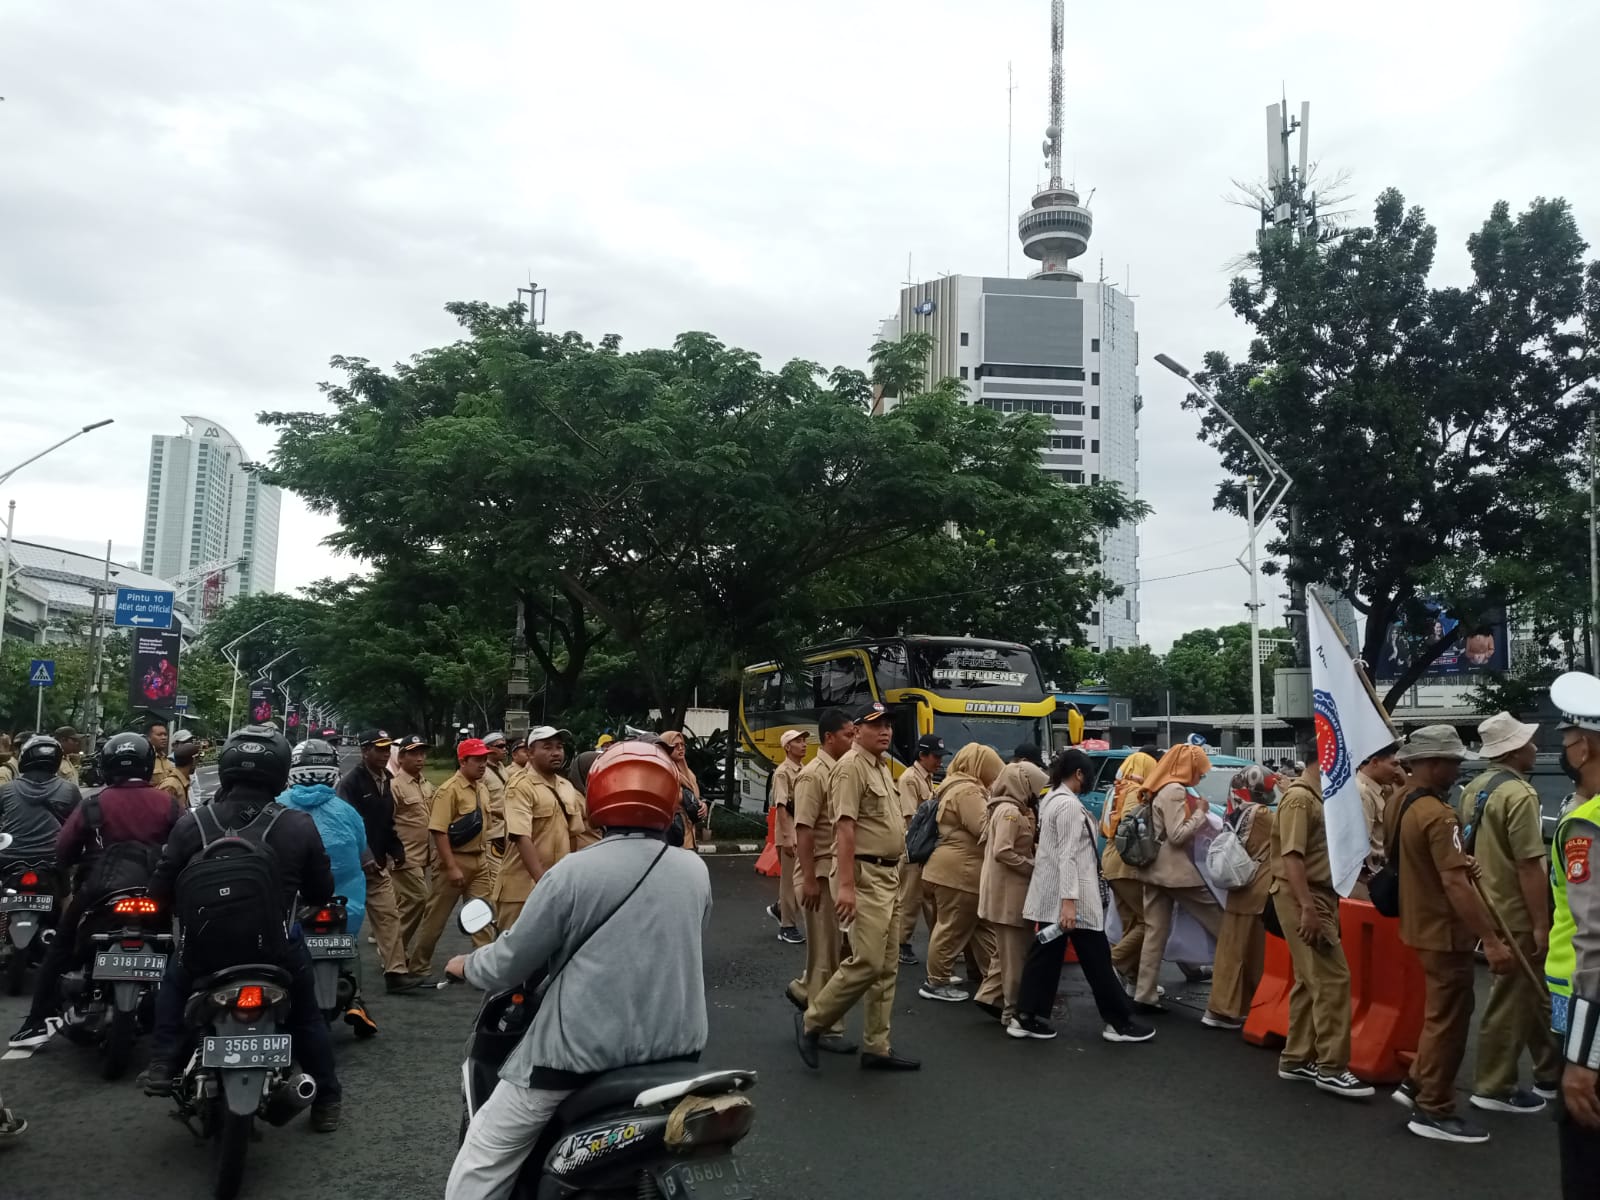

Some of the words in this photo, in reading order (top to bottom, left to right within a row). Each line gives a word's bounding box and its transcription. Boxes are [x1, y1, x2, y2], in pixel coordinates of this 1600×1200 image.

[127, 593, 150, 602] Pintu
[154, 595, 164, 603] 10
[118, 602, 134, 611] Atlet
[135, 604, 147, 612] dan
[148, 604, 170, 614] Official
[966, 670, 1029, 684] FLUENCY
[965, 703, 1021, 714] DIAMOND
[99, 956, 107, 967] B
[112, 956, 138, 967] 3181
[143, 957, 164, 969] PIH
[207, 1039, 215, 1052] B
[225, 1038, 258, 1052] 3566
[263, 1037, 289, 1051] BWP
[590, 1122, 641, 1153] REPSOL
[665, 1175, 676, 1196] B
